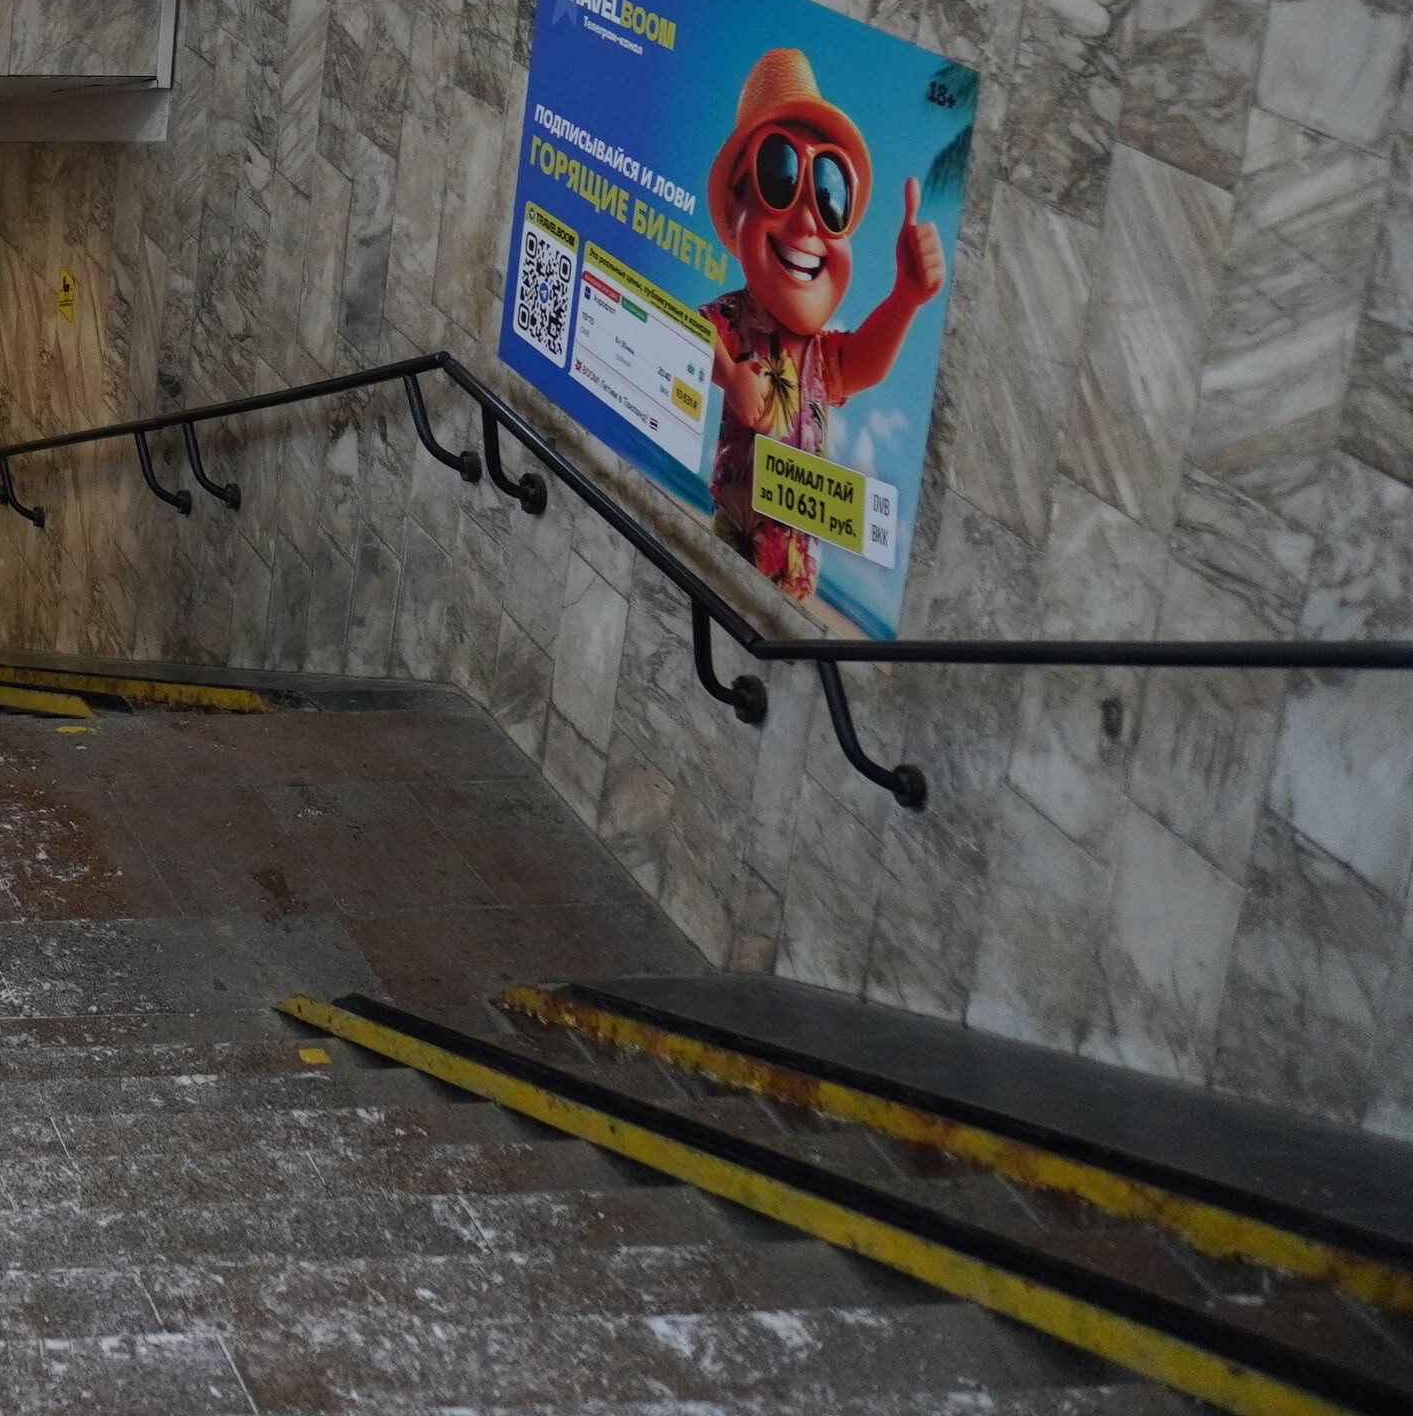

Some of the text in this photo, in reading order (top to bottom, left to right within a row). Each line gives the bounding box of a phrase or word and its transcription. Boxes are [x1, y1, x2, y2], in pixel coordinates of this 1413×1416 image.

[583, 15, 644, 56] Телеграм-канал
[928, 80, 957, 109] 18+
[534, 103, 696, 216] ПОДПИСЫВАЙСЯ И ЛОВИ
[530, 134, 728, 285] ГОРЯЩИЕ БИЛЕТЫ
[536, 212, 576, 248] TRAVELBOOM
[766, 453, 854, 505] ПОЙМАЛ ТАЙ
[760, 483, 857, 537] за 10 631 руб.
